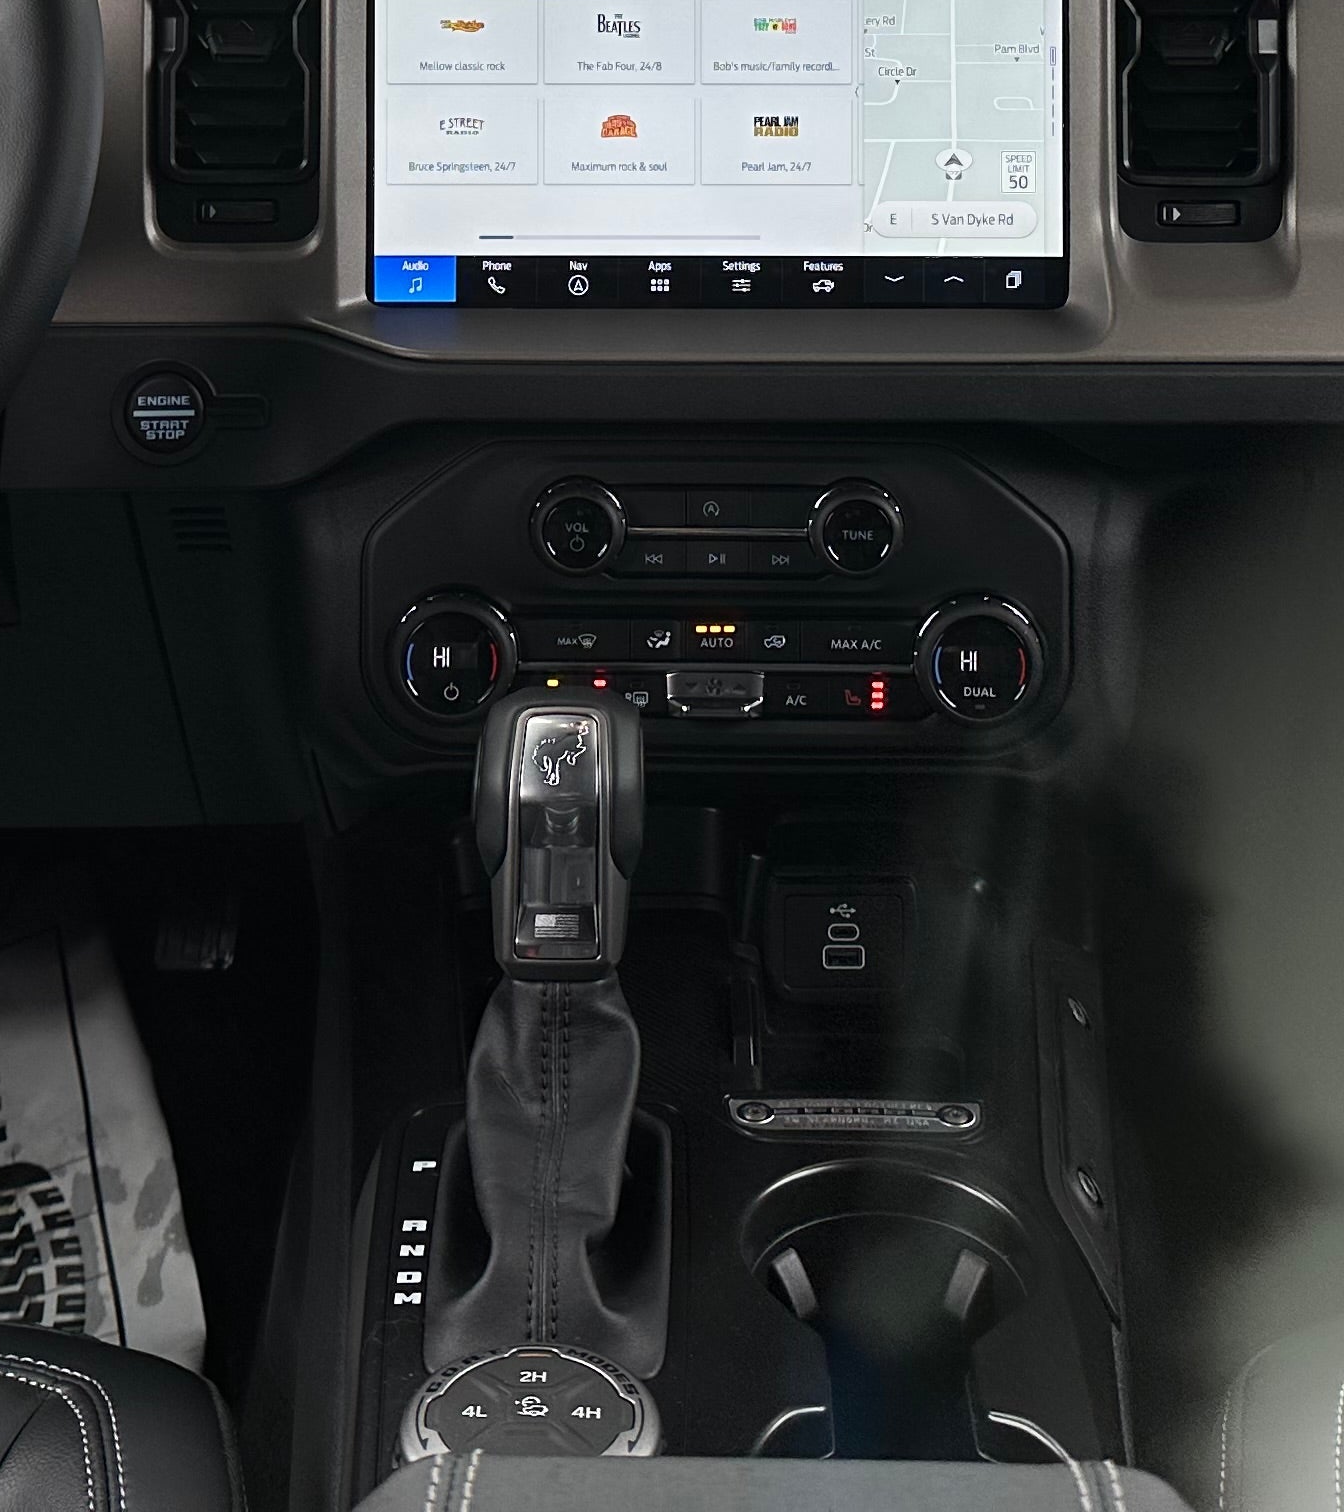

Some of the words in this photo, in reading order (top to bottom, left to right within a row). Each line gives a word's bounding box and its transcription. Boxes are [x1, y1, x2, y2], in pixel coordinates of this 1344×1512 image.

[864, 16, 880, 27] ery
[882, 16, 895, 25] Rd
[994, 45, 1016, 55] Pam
[1018, 45, 1040, 55] Blvd
[419, 61, 452, 71] Mellow
[455, 61, 484, 71] classic
[486, 61, 506, 71] rock
[577, 61, 594, 71] The
[596, 61, 613, 71] Fab
[639, 61, 662, 71] 24/8
[713, 61, 739, 72] Bob's
[740, 61, 799, 74] music/family
[878, 67, 904, 76] Circle
[906, 67, 917, 76] Dr
[448, 117, 485, 130] STREET
[754, 116, 781, 127] PEARL
[754, 127, 798, 136] RADIO
[1005, 155, 1032, 164] SPEED
[408, 162, 434, 172] Bruce
[436, 162, 493, 175] Springsteen,
[494, 162, 516, 172] 24/7
[571, 162, 617, 172] Maximum
[619, 162, 637, 172] rock
[638, 162, 645, 172] &
[648, 162, 668, 172] soul
[742, 162, 767, 172] Pearl
[790, 162, 812, 172] 24/7
[1008, 165, 1029, 173] LIMIT
[1009, 175, 1028, 189] 50
[890, 214, 897, 225] E
[931, 214, 939, 225] S
[942, 214, 964, 225] Van
[968, 214, 995, 228] Dyke
[998, 214, 1014, 225] Rd
[402, 261, 429, 272] Audio
[482, 261, 512, 272] Phone
[569, 261, 588, 272] Nav
[648, 261, 672, 274] Apps
[722, 261, 761, 274] Settings
[803, 261, 844, 272] Features
[137, 395, 191, 406] ENGINE
[140, 420, 189, 430] START
[146, 430, 185, 440] STOP
[564, 522, 589, 533] VOL
[842, 530, 874, 541] TUNE
[557, 636, 578, 646] MAX
[700, 637, 734, 649] AUTO
[830, 638, 858, 650] MAX
[859, 638, 882, 650] A/C
[433, 647, 451, 668] HI
[960, 651, 978, 671] HI
[963, 686, 996, 697] DUAL
[785, 694, 807, 706] A/C
[412, 1161, 437, 1172] P
[400, 1244, 425, 1256] N
[396, 1271, 422, 1284] D
[394, 1292, 422, 1304] M
[520, 1370, 547, 1383] 2H
[567, 1348, 640, 1396] MODES
[461, 1405, 488, 1418] 4L
[571, 1406, 602, 1420] 4H
